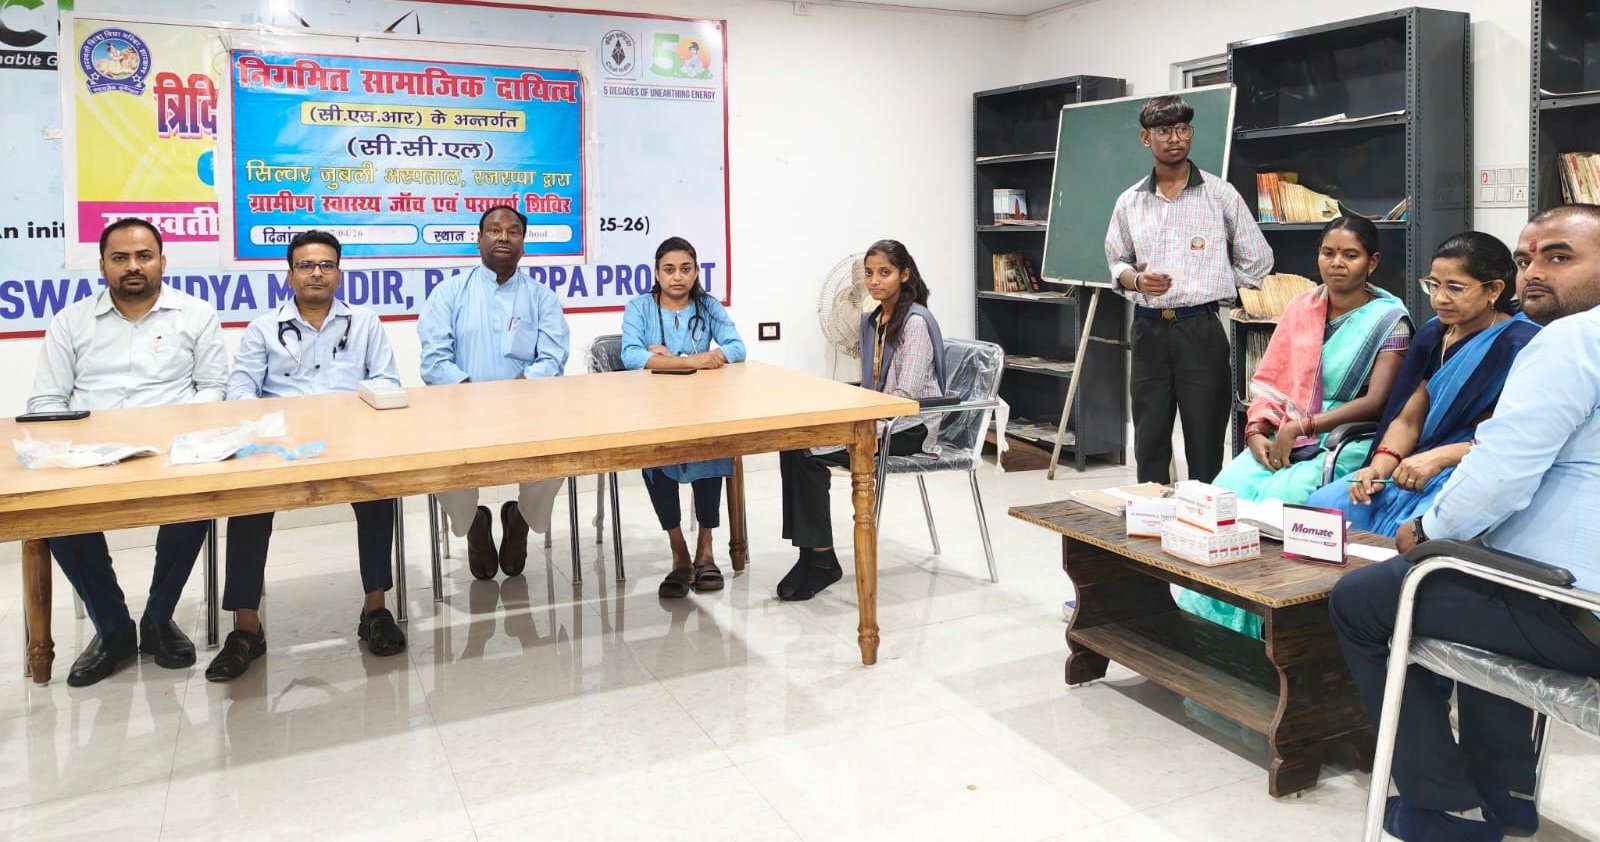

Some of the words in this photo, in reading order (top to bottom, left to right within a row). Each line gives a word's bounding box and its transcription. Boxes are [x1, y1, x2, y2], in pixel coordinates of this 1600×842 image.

[237, 56, 350, 91] निगमित
[360, 68, 486, 97] सामाजिक
[494, 74, 577, 102] दायित्व
[603, 86, 608, 95] 5
[609, 87, 639, 96] DECADES
[640, 88, 648, 97] OF
[650, 88, 690, 98] UNEARTHING
[691, 90, 716, 99] ENERGY
[310, 104, 422, 126] (सी.एस.आर)
[431, 110, 447, 125] के
[454, 111, 520, 128] अन्तर्गत
[348, 134, 494, 161] (सी.सी.एल)
[246, 159, 312, 183] सिल्वर
[320, 161, 377, 190] जुबली
[384, 167, 466, 188] अस्पताल,
[473, 169, 536, 186] रजरप्पा
[542, 172, 572, 188] द्वारा
[249, 191, 315, 213] ग्रामीण
[431, 192, 459, 212] एवं
[525, 194, 571, 212] शिविर
[263, 227, 305, 243] दिनां
[600, 215, 649, 235] 25-26)
[434, 230, 466, 243] स्थान
[596, 262, 716, 296] PROT
[1291, 522, 1334, 538] Momate
